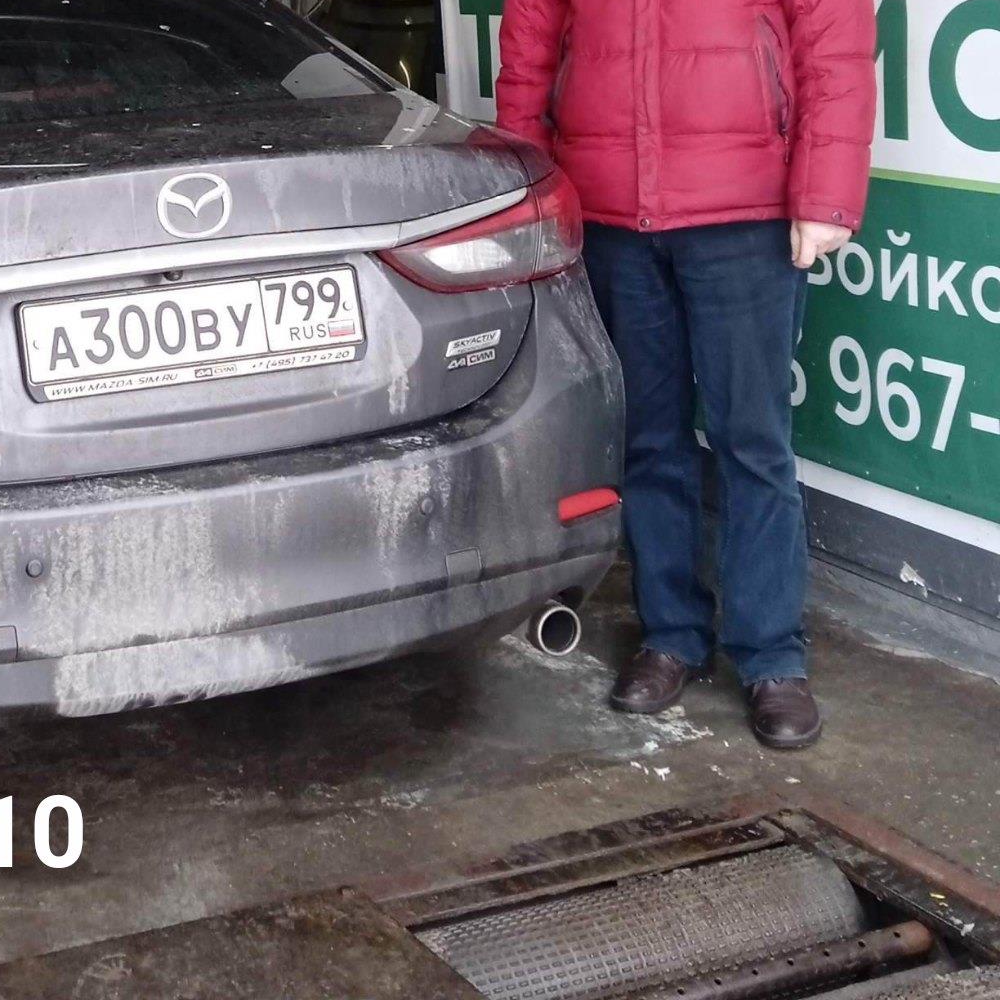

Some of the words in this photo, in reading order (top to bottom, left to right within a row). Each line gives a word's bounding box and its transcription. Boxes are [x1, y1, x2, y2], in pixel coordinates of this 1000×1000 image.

[264, 276, 341, 325] 799
[289, 325, 327, 341] RUS
[452, 333, 497, 349] SKYACTIV
